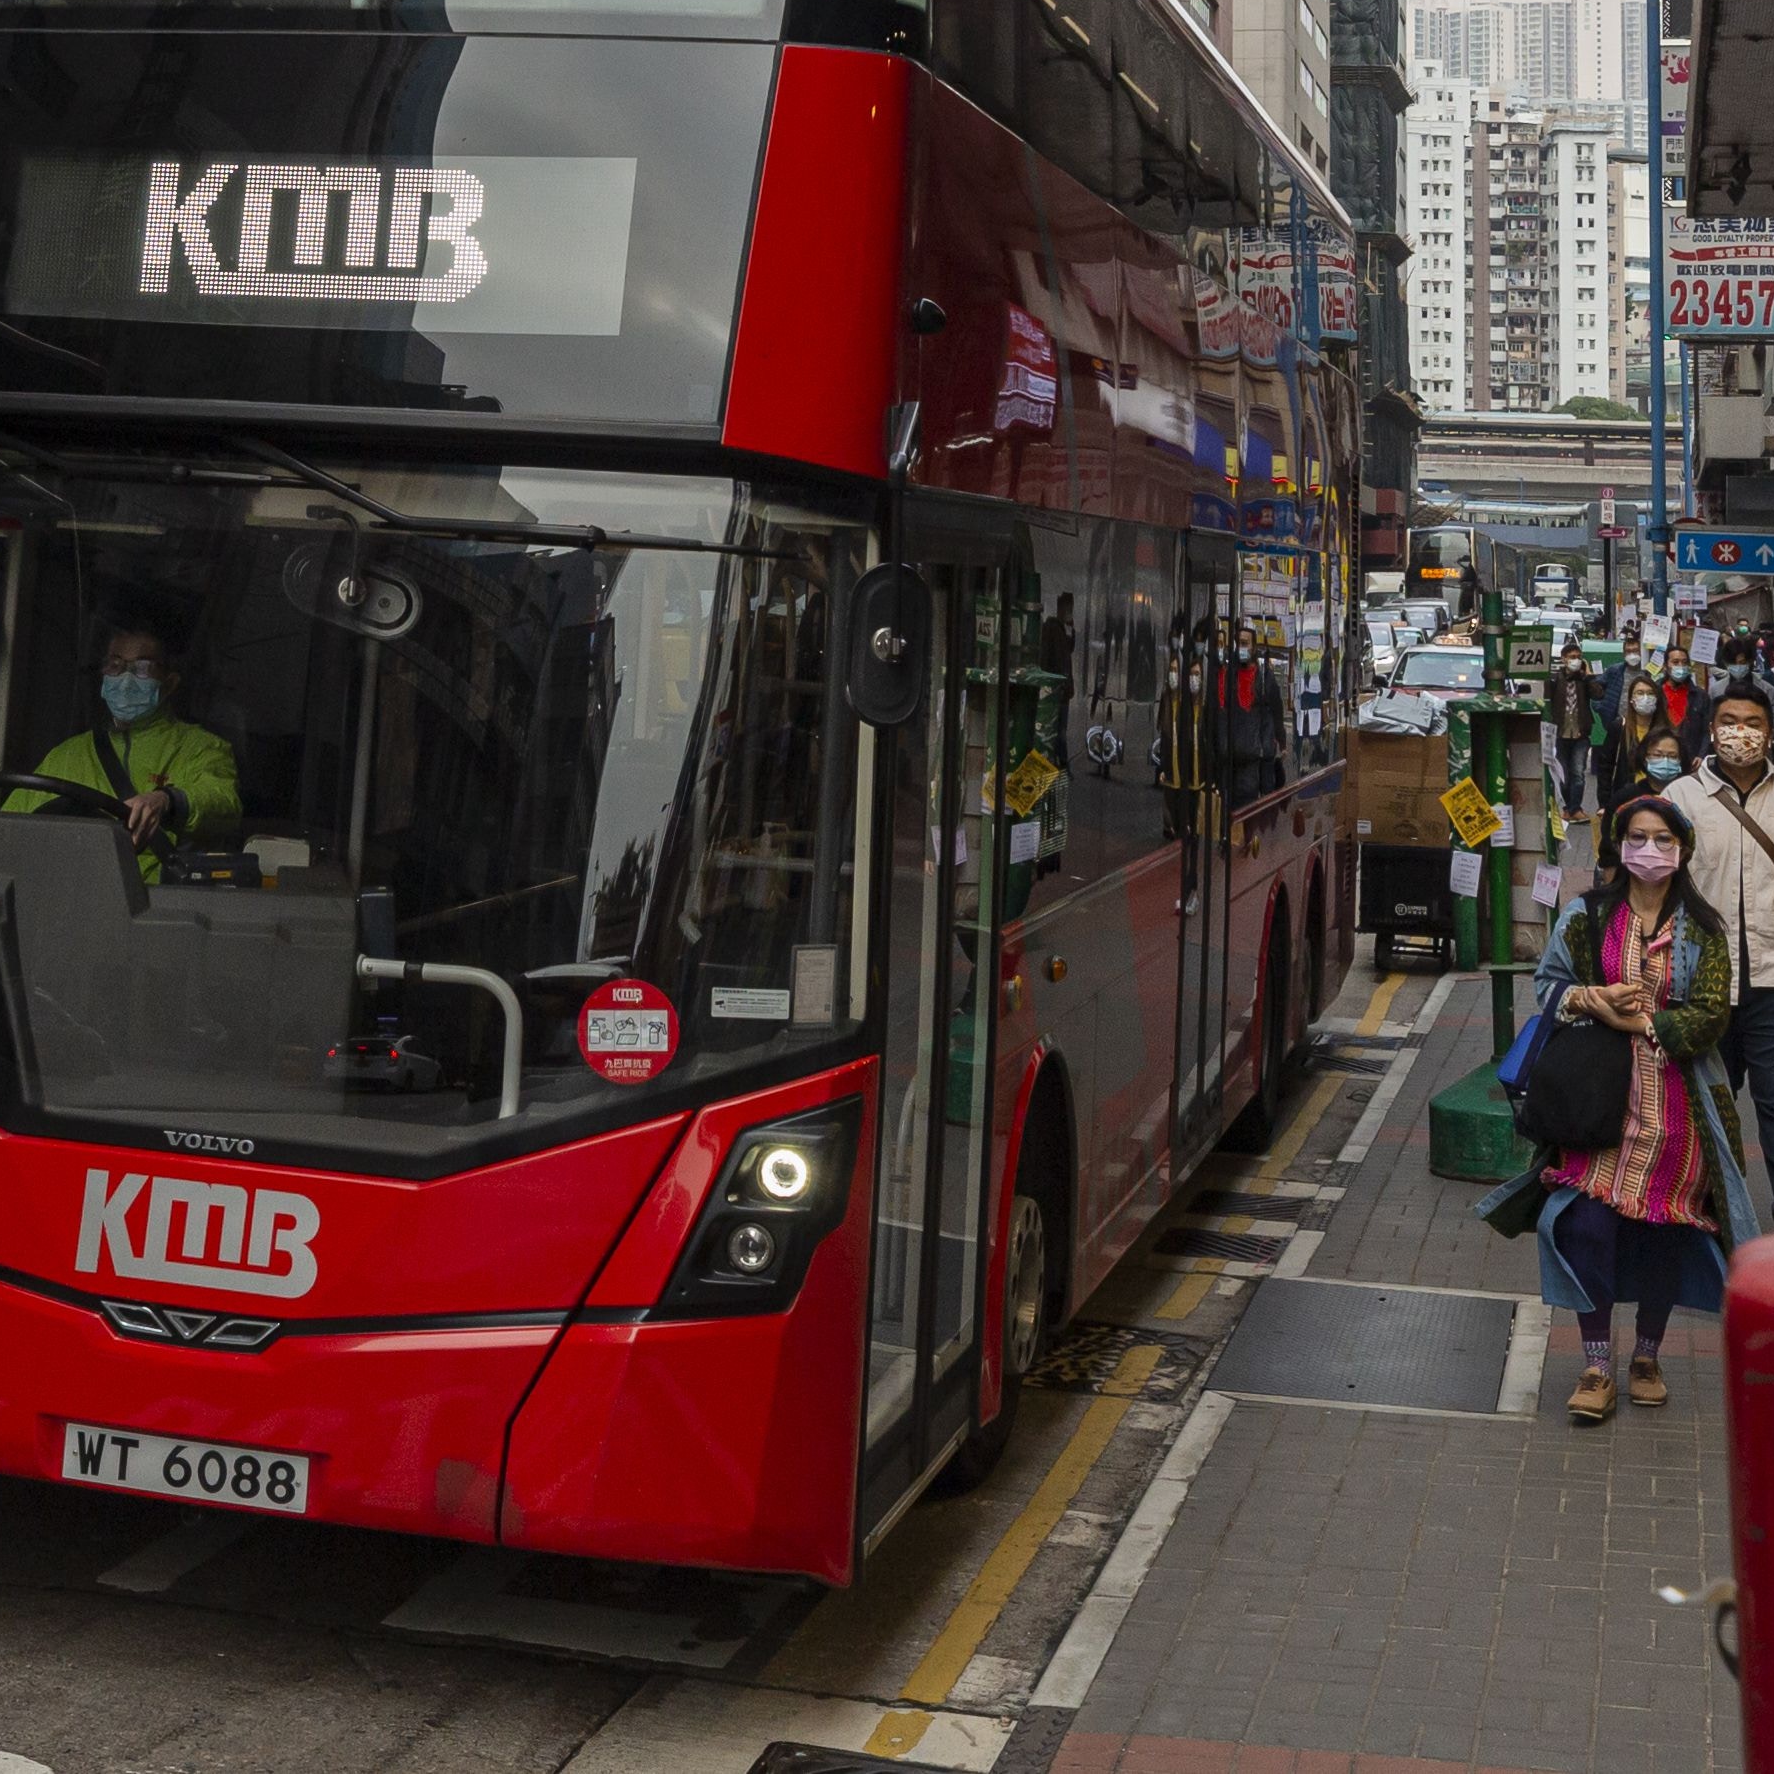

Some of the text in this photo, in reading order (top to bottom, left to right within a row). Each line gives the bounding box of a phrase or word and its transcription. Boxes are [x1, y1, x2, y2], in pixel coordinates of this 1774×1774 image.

[138, 159, 489, 304] KMB
[1692, 234, 1711, 242] GOOD
[1516, 649, 1544, 666] 22A
[612, 988, 643, 1003] KMB
[608, 1069, 648, 1077] SAFE RIDE
[163, 1130, 255, 1154] VOLVO
[74, 1167, 321, 1299] KMB
[77, 1424, 298, 1505] WT 6088
